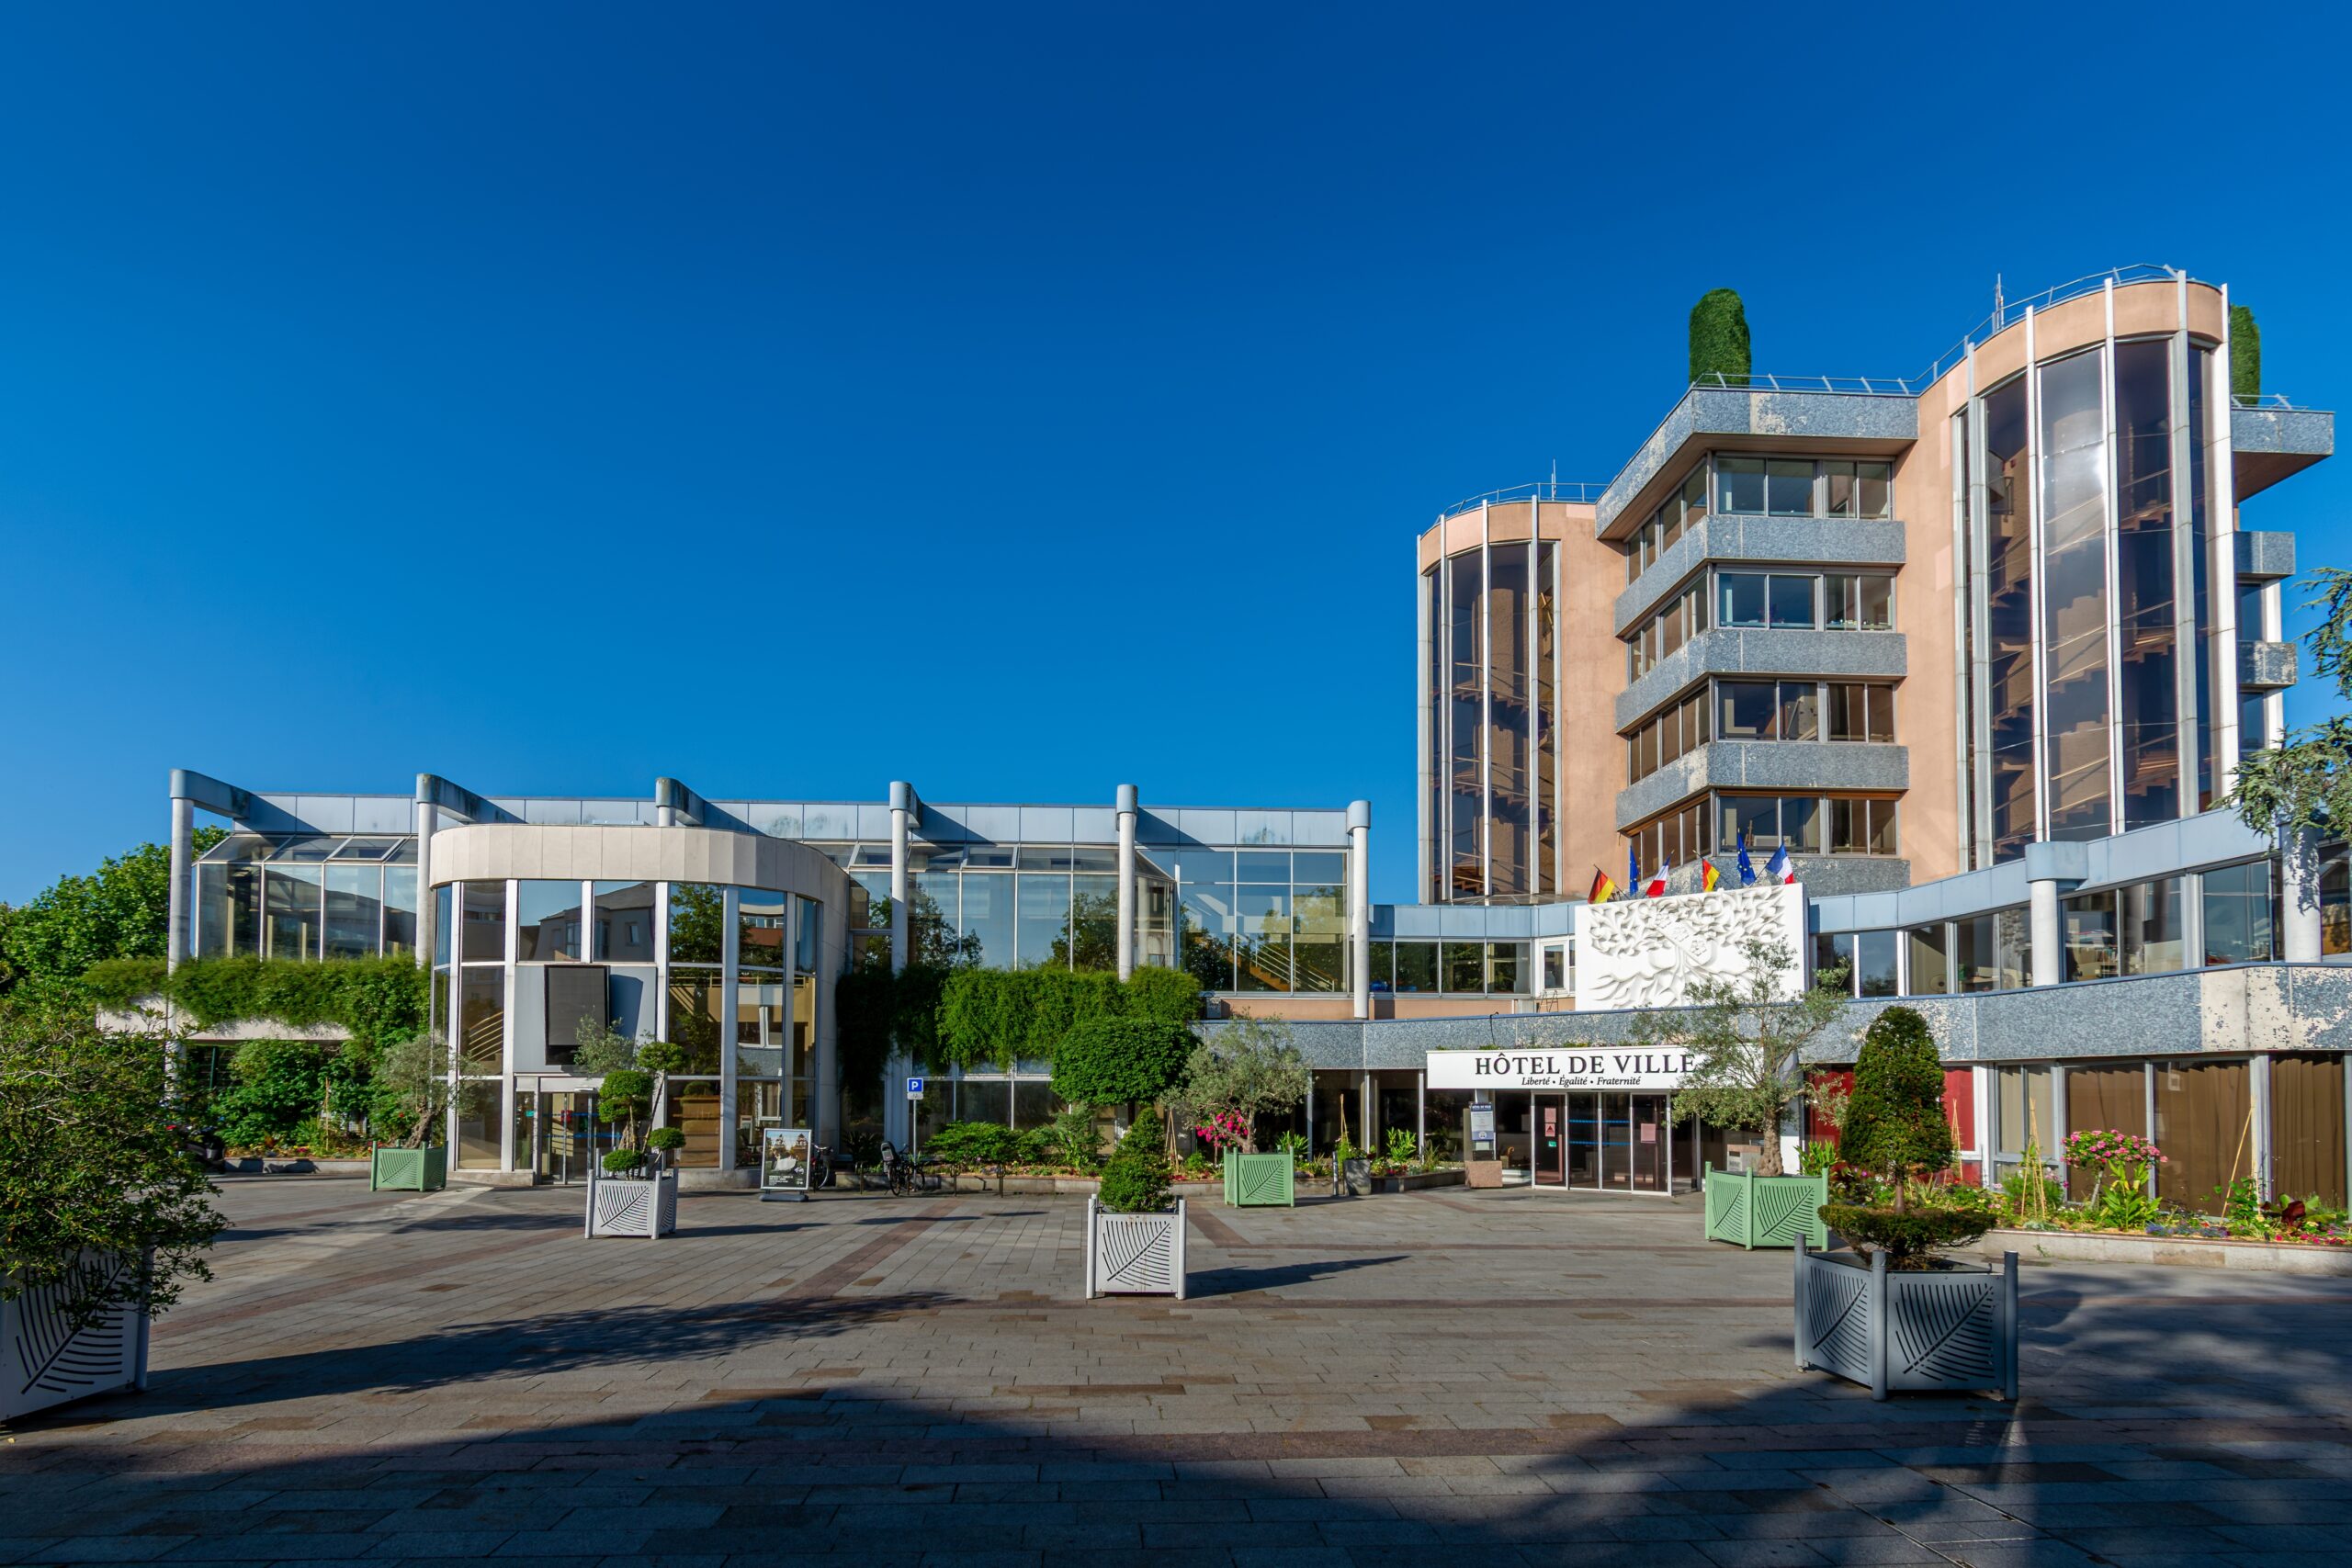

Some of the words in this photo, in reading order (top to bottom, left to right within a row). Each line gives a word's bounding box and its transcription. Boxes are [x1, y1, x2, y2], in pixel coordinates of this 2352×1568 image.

[1475, 1052, 1560, 1075] HÔTEL
[1568, 1055, 1604, 1074] DE
[1612, 1054, 1697, 1074] VILLE
[911, 1081, 919, 1090] P
[1521, 1077, 1551, 1086] Liberté
[1558, 1074, 1588, 1088] Égalité
[1597, 1076, 1641, 1086] Fraternité
